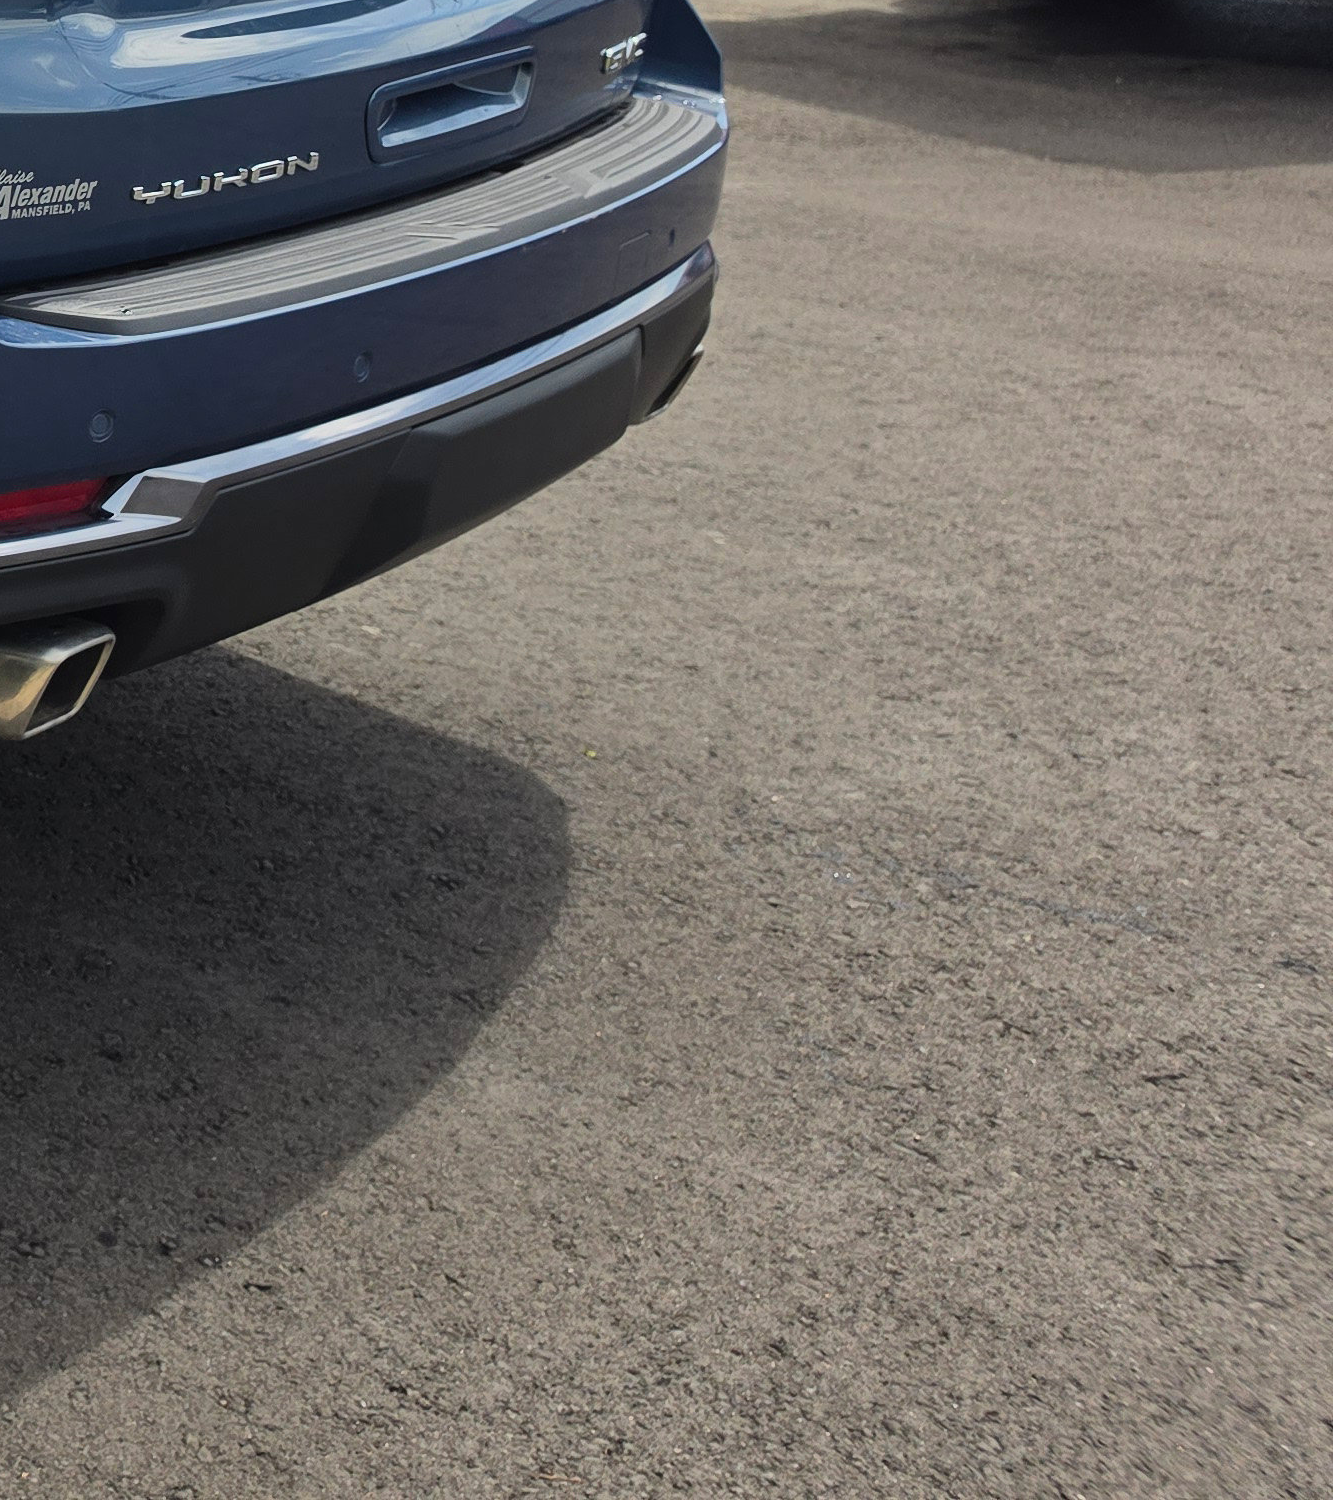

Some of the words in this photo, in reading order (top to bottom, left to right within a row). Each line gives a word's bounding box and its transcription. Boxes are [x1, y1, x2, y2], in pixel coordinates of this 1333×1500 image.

[132, 151, 319, 204] YUKON
[11, 204, 75, 220] MANSFIELD,
[77, 200, 91, 212] PA
